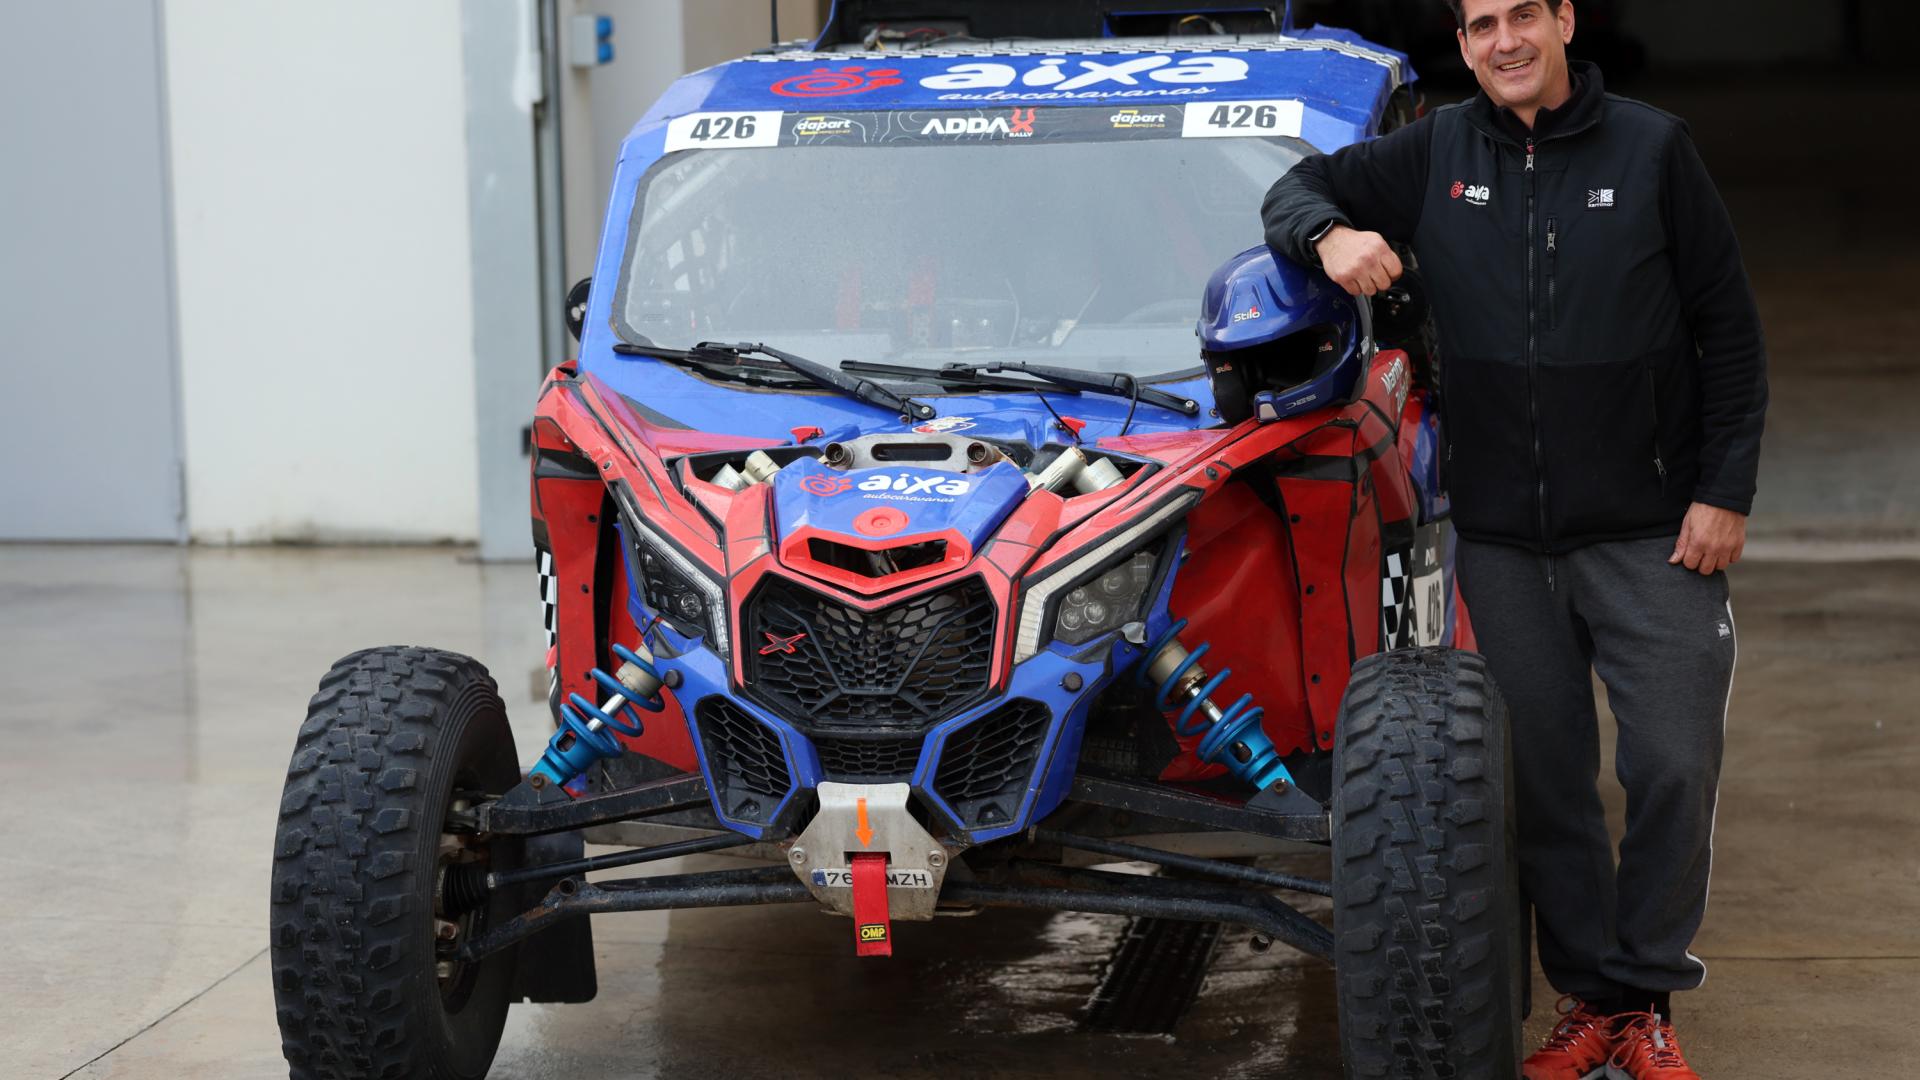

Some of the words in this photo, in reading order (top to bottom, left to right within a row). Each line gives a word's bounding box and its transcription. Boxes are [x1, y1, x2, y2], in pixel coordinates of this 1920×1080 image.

[919, 55, 1249, 91] aixa
[938, 86, 1216, 101] autocaravanas
[1110, 113, 1166, 125] dapart
[1208, 104, 1277, 129] 426
[690, 115, 756, 141] 426
[798, 117, 851, 132] dapart
[1234, 306, 1261, 322] Stilo
[858, 473, 970, 495] aixa
[863, 492, 955, 503] autocaravanas
[861, 927, 886, 939] OMP
